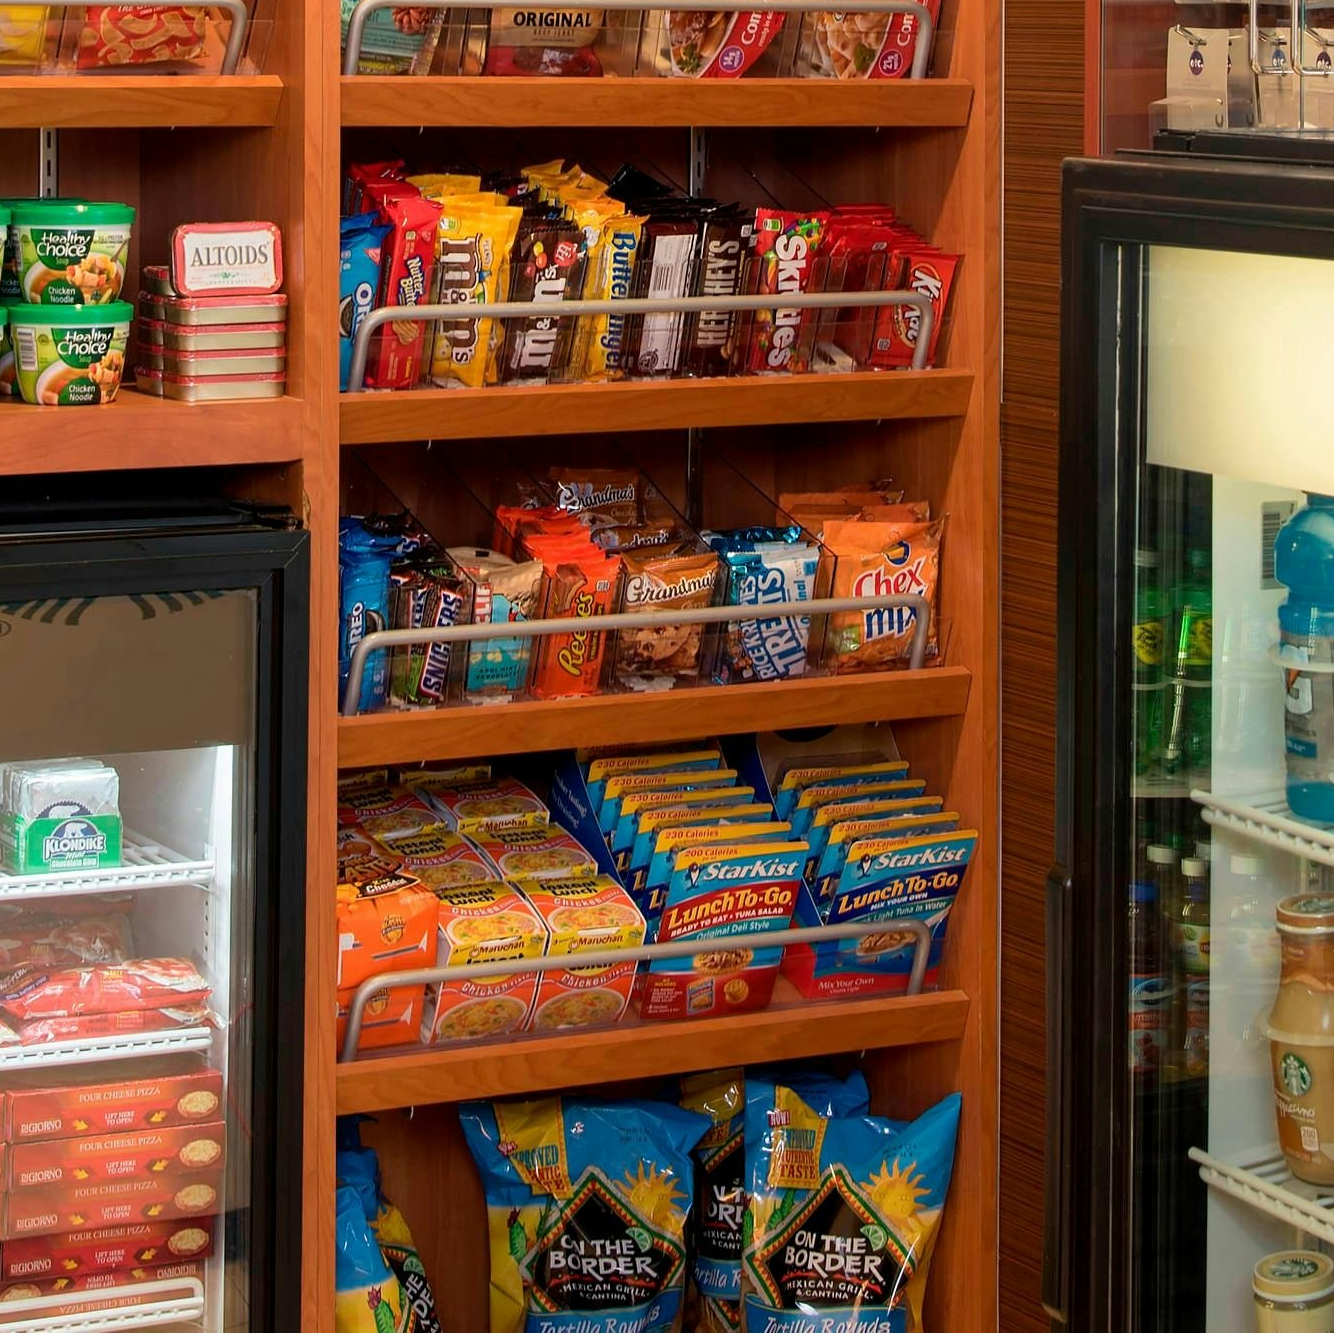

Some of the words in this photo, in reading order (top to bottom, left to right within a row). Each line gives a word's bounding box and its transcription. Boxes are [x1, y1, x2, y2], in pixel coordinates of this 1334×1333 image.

[513, 11, 591, 27] ORIGINAL
[37, 241, 86, 257] Choice
[42, 232, 92, 251] Healthy
[190, 243, 268, 268] ALTOIDS
[407, 257, 423, 294] Nutter
[48, 287, 76, 296] Chicken
[50, 295, 74, 304] Noodle
[57, 339, 108, 356] Choice
[66, 331, 112, 348] Healthy
[69, 384, 96, 394] Chicken
[70, 392, 93, 402] Noodle
[854, 560, 924, 598] Chex
[686, 829, 719, 837] Calories
[43, 833, 106, 860] KLONDIKE
[685, 849, 702, 857] 200
[705, 847, 738, 855] Calories
[875, 845, 966, 869] StarKist
[703, 858, 799, 880] StarKist
[554, 897, 601, 907] Chicken
[838, 879, 904, 914] Lunch
[870, 902, 885, 911] MIX
[887, 896, 907, 906] YOUR
[909, 892, 928, 901] OWN
[452, 903, 499, 916] Chicken
[668, 890, 734, 930] Lunch
[897, 906, 913, 915] Tuna
[671, 922, 698, 937] READY
[713, 915, 727, 925] EAT
[735, 909, 756, 919] TUNA
[758, 907, 783, 915] SALAD
[697, 927, 729, 941] Original
[732, 923, 747, 933] Deli
[750, 920, 769, 930] Style
[479, 940, 524, 954] Maruchan
[578, 934, 623, 946] Maruchan
[561, 973, 607, 987] Chicken
[79, 1091, 101, 1102] FOUR
[103, 1089, 135, 1101] CHEESE
[137, 1087, 161, 1096] PIZZA
[80, 1140, 103, 1152] FOUR
[104, 1138, 136, 1150] CHEESE
[138, 1136, 162, 1145] PIZZA
[779, 1165, 816, 1179] TASTE
[591, 1239, 634, 1256] THE
[795, 1230, 816, 1252] ON
[821, 1235, 866, 1254] THE
[550, 1250, 658, 1281] BORDER
[784, 1246, 883, 1282] BORDER
[586, 1292, 626, 1301] CANTINA
[805, 1290, 849, 1300] CANTINA
